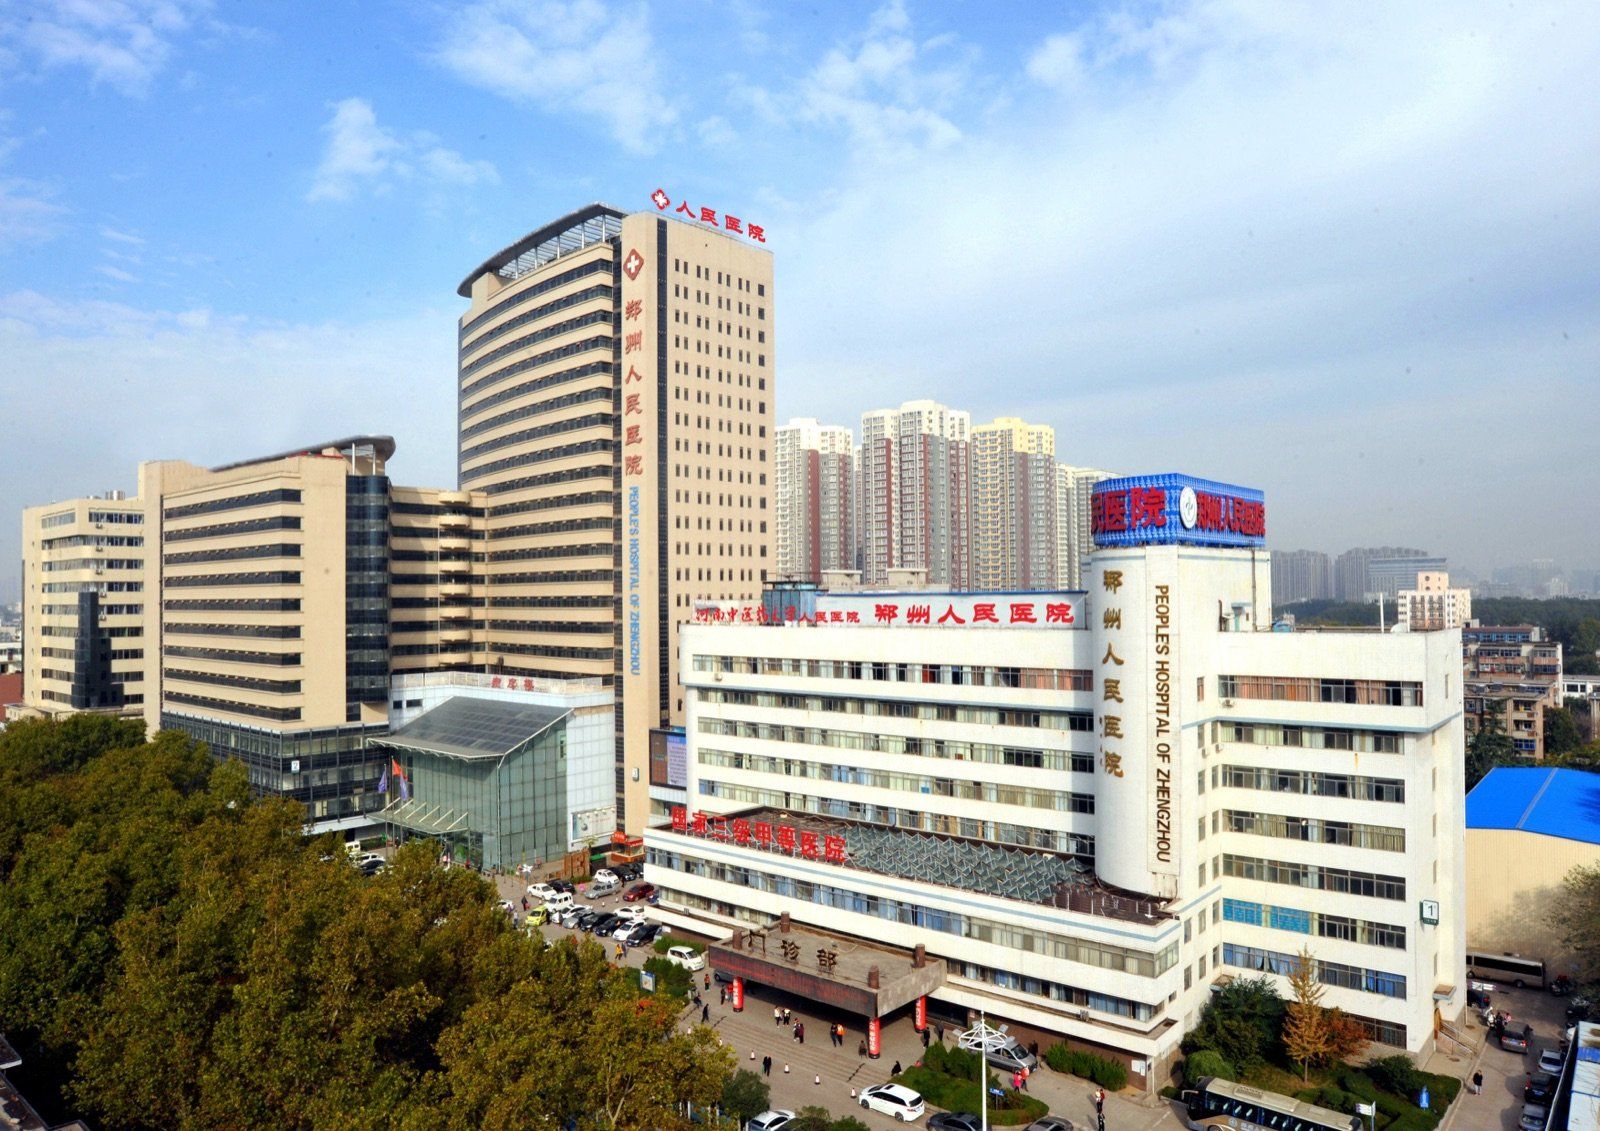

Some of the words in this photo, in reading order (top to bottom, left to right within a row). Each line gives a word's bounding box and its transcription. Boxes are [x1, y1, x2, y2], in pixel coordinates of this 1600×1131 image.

[676, 201, 766, 243] 人民医院
[625, 300, 643, 477] 郑州人民医院
[629, 539, 639, 590] HOSPITAL
[630, 595, 639, 608] OF
[874, 603, 1075, 625] 郑州人民医院
[629, 611, 640, 676] ZHENGZHOU
[1103, 569, 1124, 778] 郑州人民医院
[1155, 660, 1170, 738] HOSPITAL
[1156, 743, 1170, 764] OF
[1156, 768, 1171, 863] ZHENGZHOU
[1428, 905, 1433, 916] 1
[748, 930, 837, 968] 门诊部
